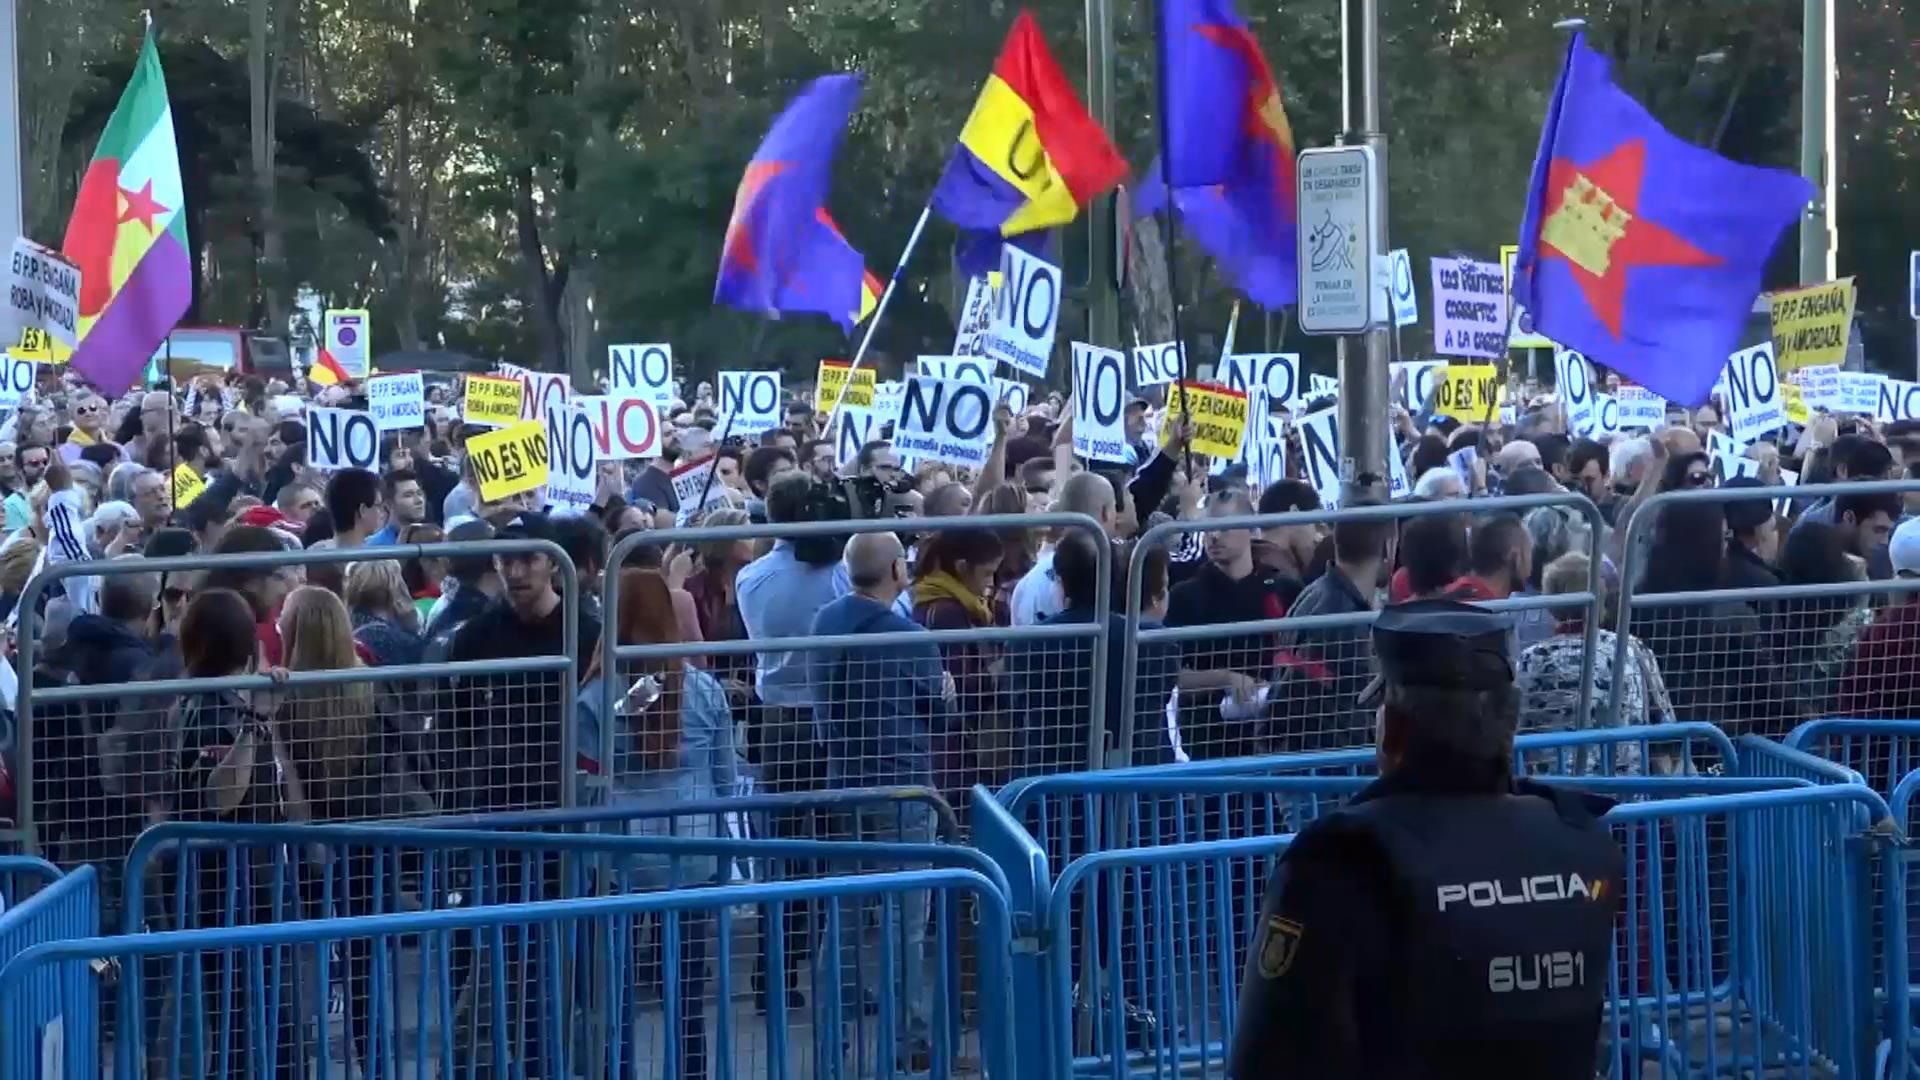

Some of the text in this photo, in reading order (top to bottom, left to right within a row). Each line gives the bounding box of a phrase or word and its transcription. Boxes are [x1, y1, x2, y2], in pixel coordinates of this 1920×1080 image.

[992, 251, 1056, 340] NO
[613, 347, 669, 388] NO
[1073, 347, 1122, 428] NO
[1138, 345, 1179, 383] NO
[1229, 357, 1294, 402] NO
[1727, 351, 1774, 412] NO
[722, 375, 777, 415] NO
[899, 377, 990, 440] NO
[1453, 379, 1473, 406] ES
[309, 410, 376, 468] NO
[472, 433, 549, 485] NO ES NO
[549, 406, 594, 480] NO
[1302, 413, 1340, 491] N
[1437, 873, 1590, 911] POLICIA
[1488, 951, 1585, 992] 6U131
